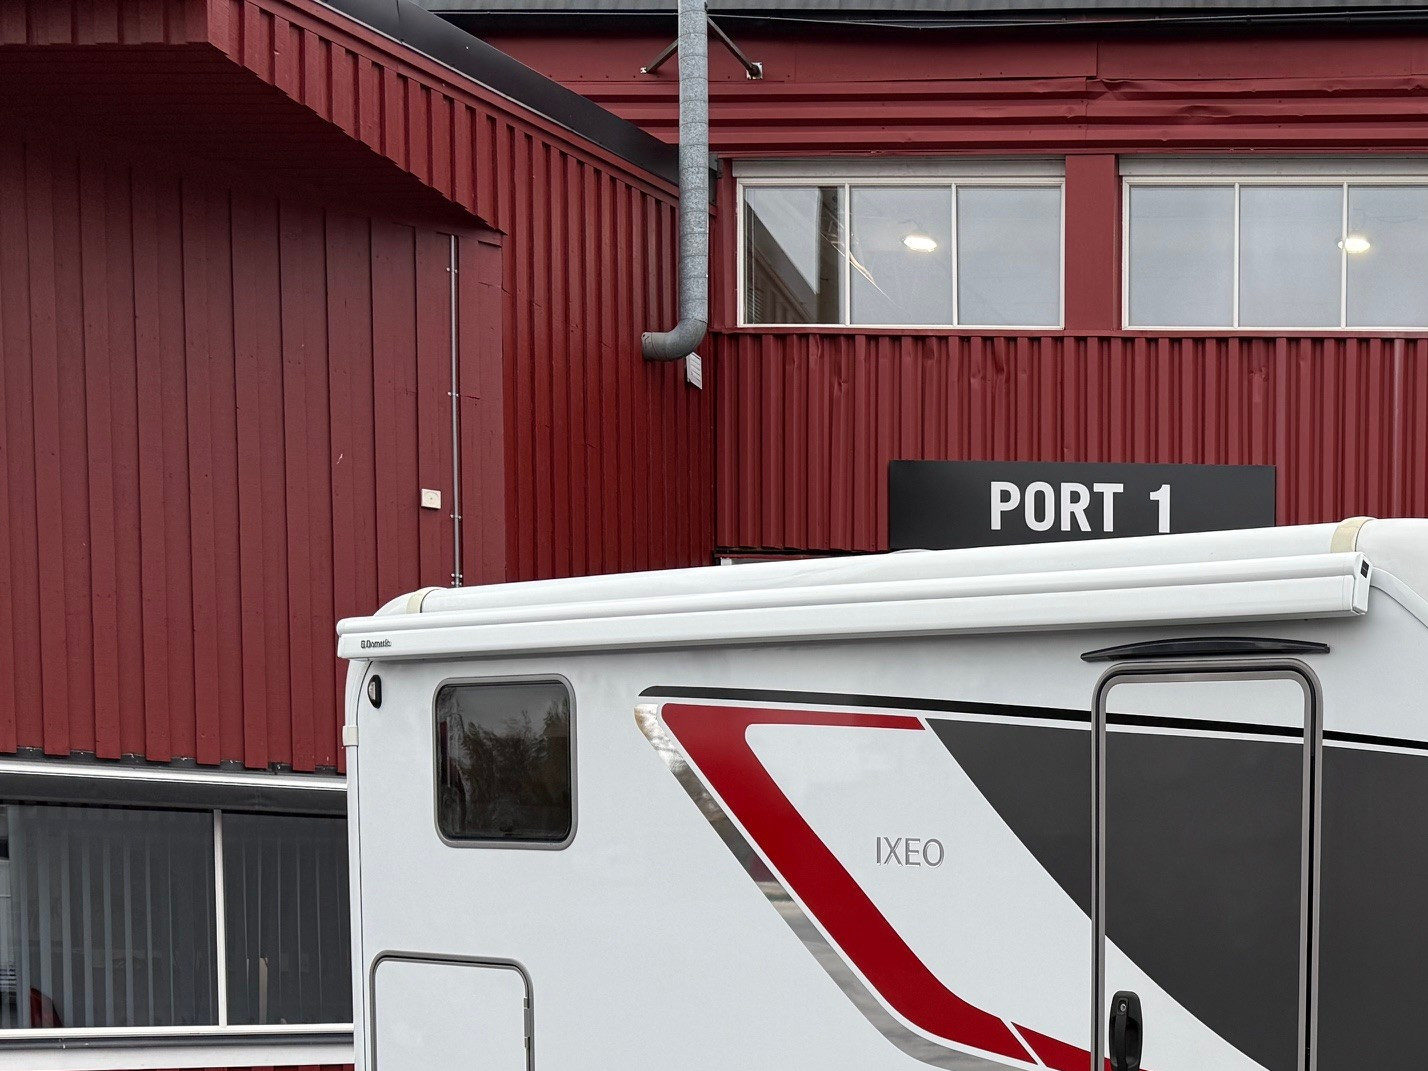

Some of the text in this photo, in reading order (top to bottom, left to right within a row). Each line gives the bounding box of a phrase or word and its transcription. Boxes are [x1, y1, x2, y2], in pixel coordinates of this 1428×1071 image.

[990, 481, 1171, 533] PORT 1
[876, 836, 945, 867] IXEO
